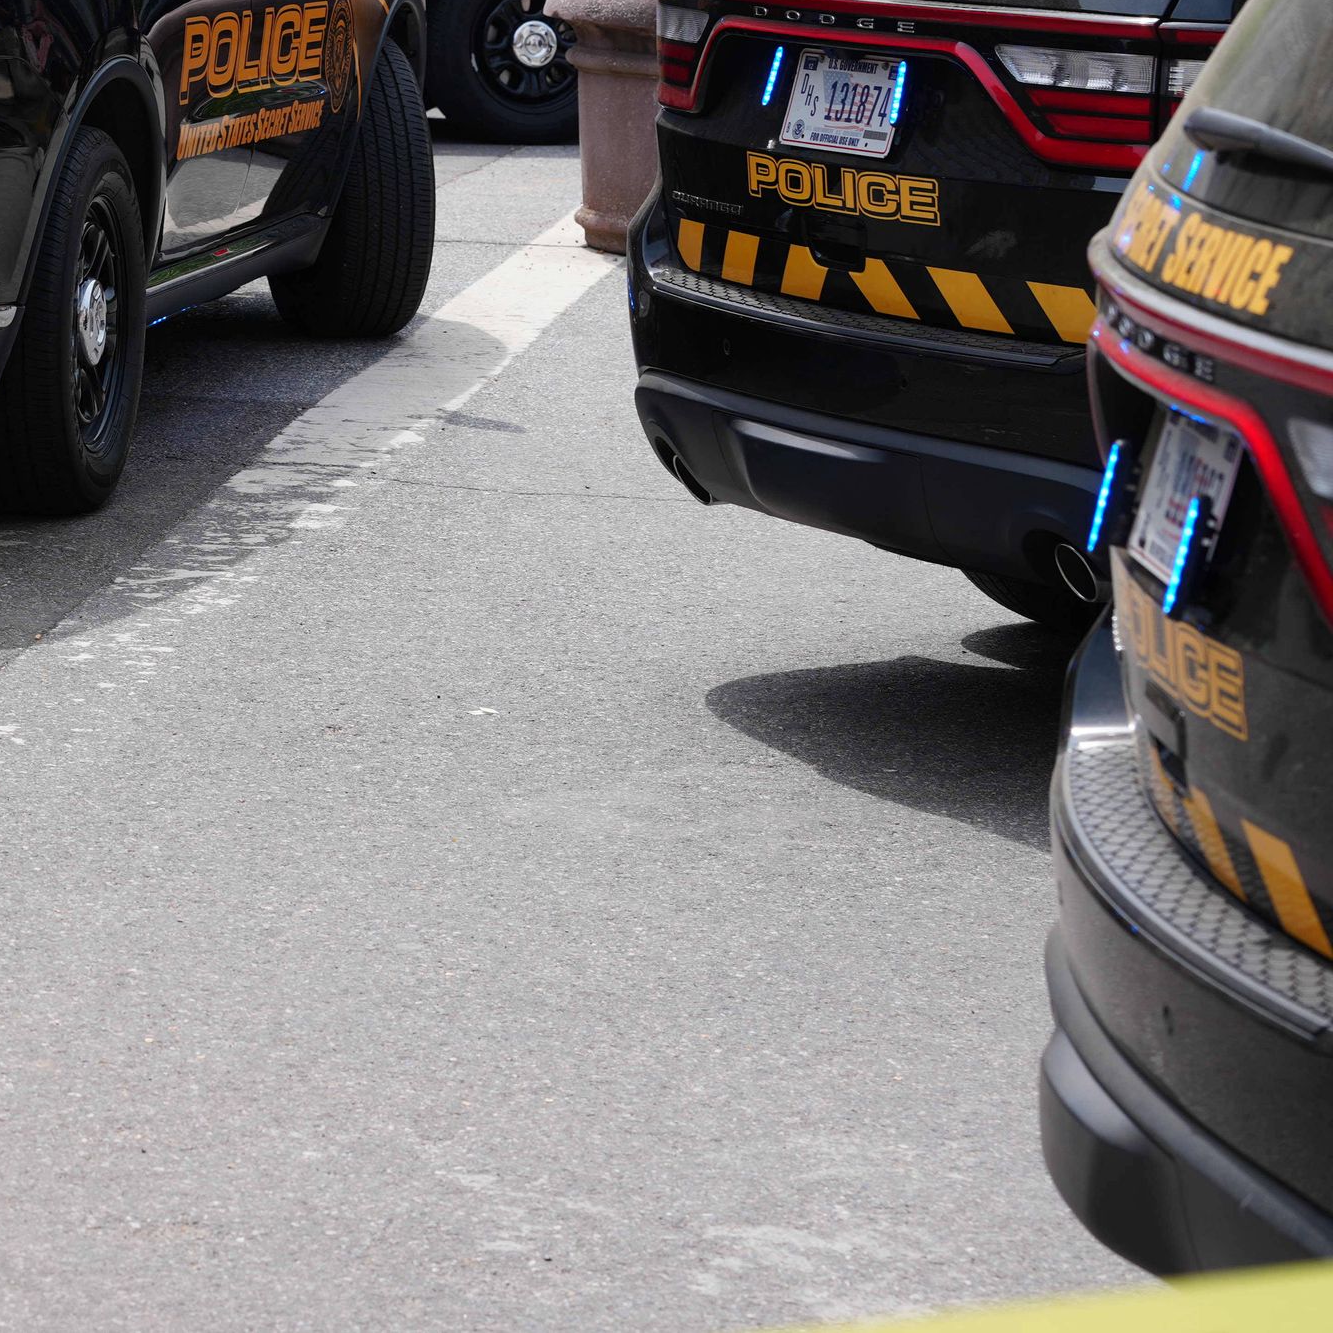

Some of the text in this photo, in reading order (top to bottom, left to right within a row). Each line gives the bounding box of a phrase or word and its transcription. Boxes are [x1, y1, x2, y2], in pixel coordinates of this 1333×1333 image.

[179, 1, 329, 106] POLICE
[754, 6, 916, 35] DODGE
[176, 99, 326, 161] UNITED STATES SECRET SERVICE
[824, 81, 892, 128] 131874
[746, 151, 941, 226] POLICE
[1161, 211, 1295, 317] SERVICE
